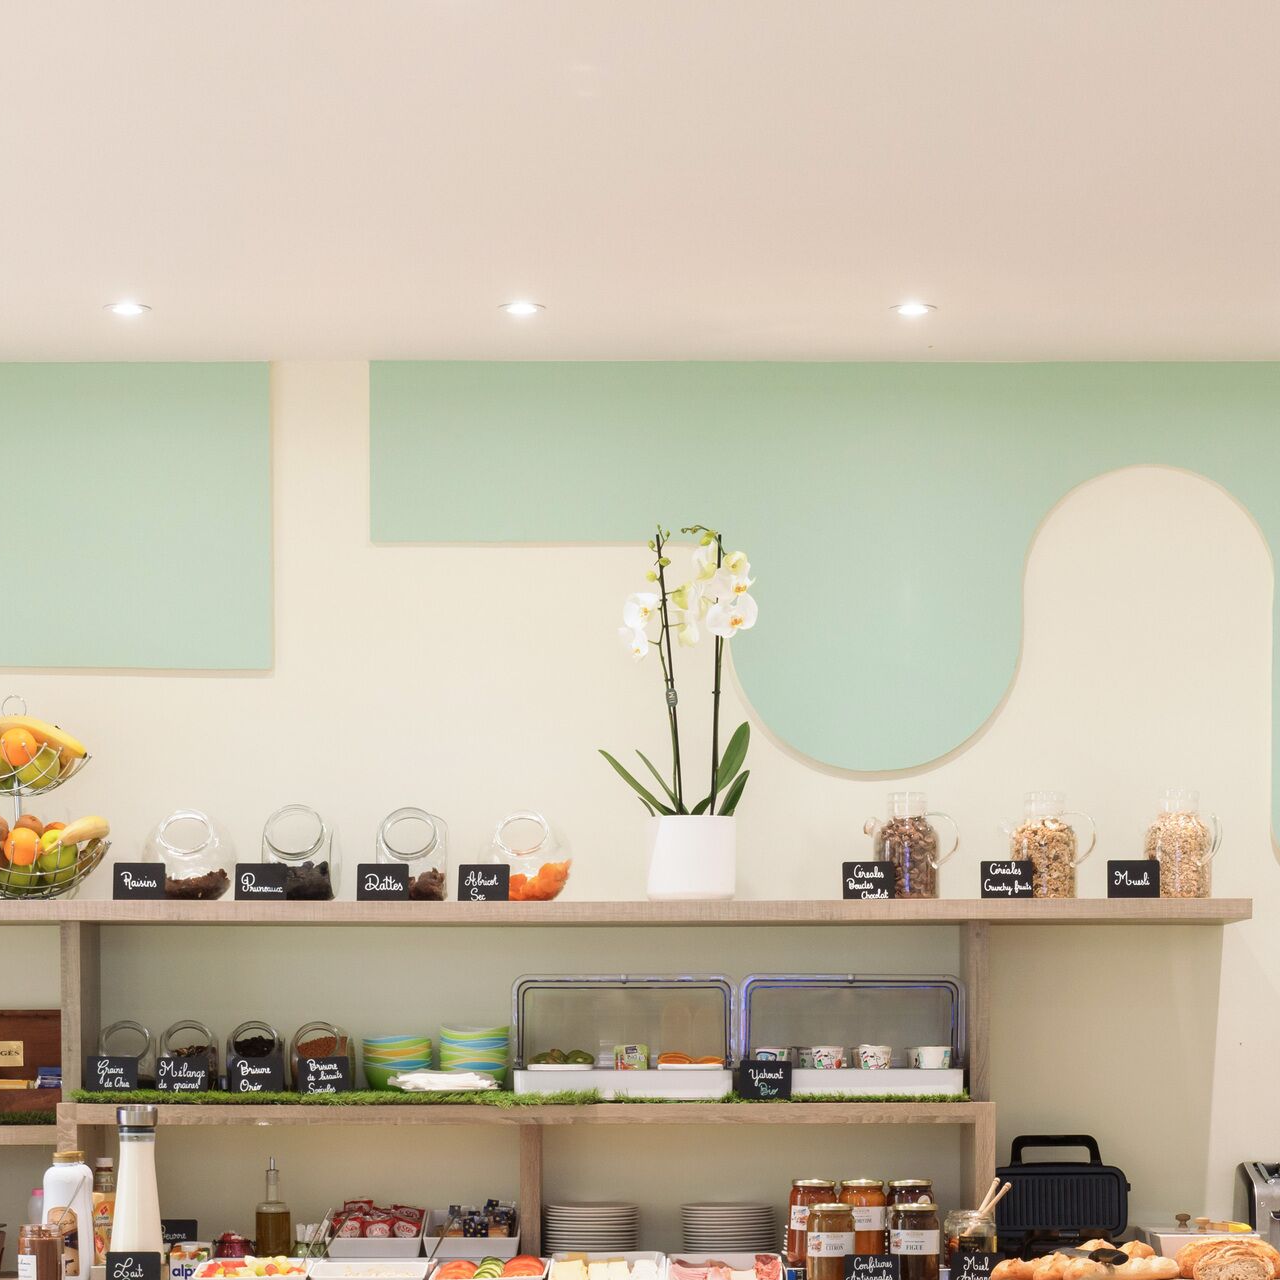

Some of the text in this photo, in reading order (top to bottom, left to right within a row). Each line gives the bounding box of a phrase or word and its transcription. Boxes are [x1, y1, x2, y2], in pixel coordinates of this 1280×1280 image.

[120, 870, 158, 890] Raisins
[240, 872, 283, 893] Pruneaux
[364, 873, 404, 891] Dattes
[464, 871, 499, 887] Abricot
[1114, 870, 1151, 886] Muesli
[470, 887, 486, 901] Sec
[861, 888, 889, 900] Chocolat
[984, 881, 1012, 896] Crunchy
[97, 1060, 124, 1084] Graine
[159, 1060, 206, 1085] Mélange
[307, 1073, 316, 1082] de
[748, 1068, 784, 1087] Yahourt
[104, 1077, 130, 1088] de Chia
[159, 1079, 199, 1093] de graines
[759, 1082, 779, 1096] Bio
[113, 1257, 144, 1278] Lait
[853, 1256, 893, 1274] Confitures
[963, 1256, 989, 1271] Miel
